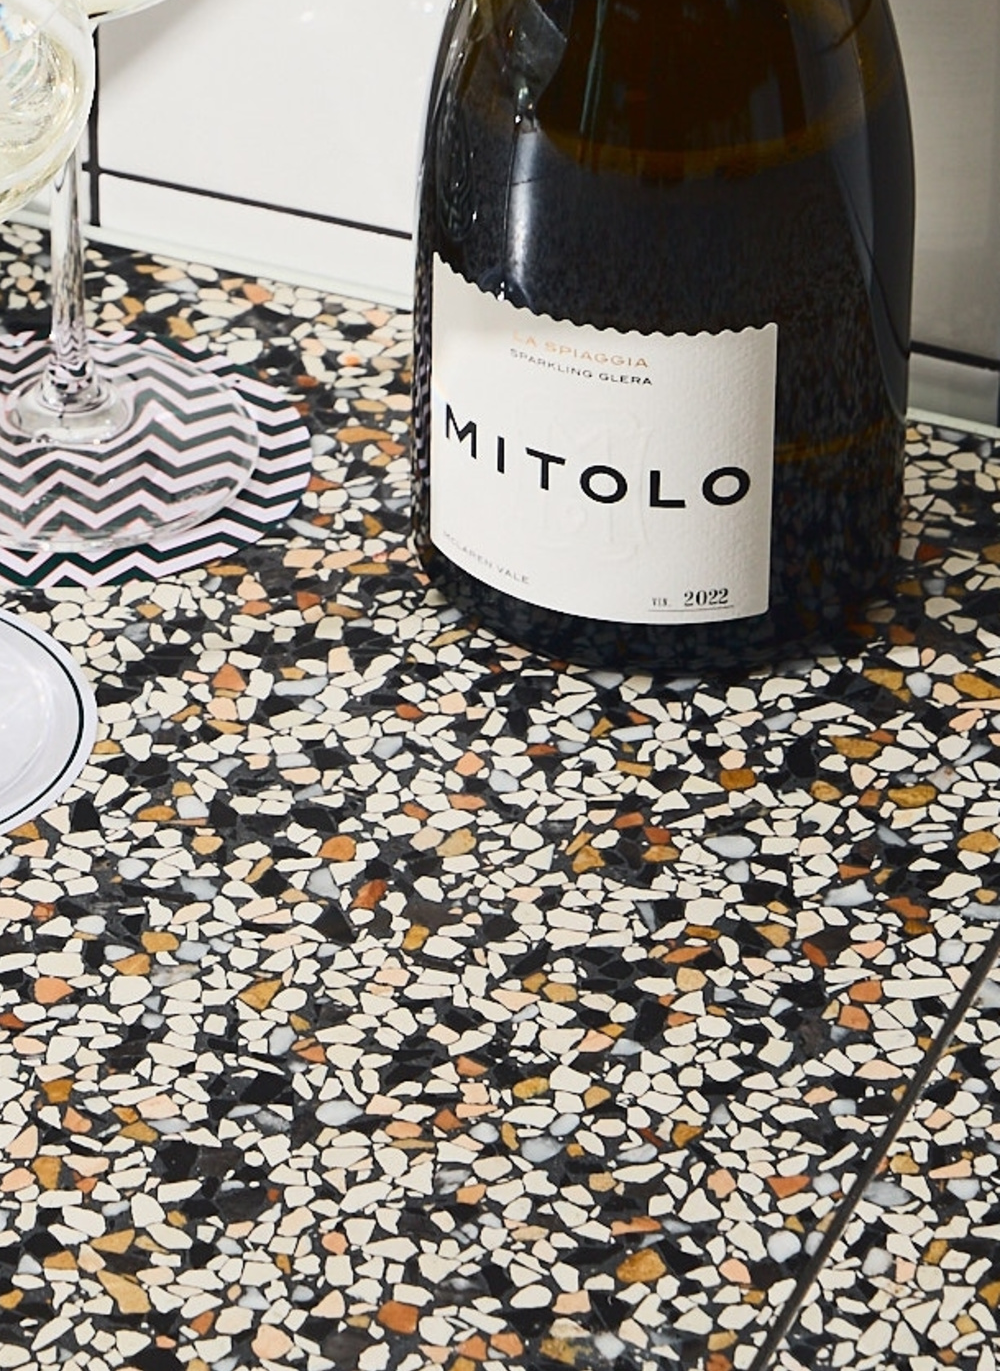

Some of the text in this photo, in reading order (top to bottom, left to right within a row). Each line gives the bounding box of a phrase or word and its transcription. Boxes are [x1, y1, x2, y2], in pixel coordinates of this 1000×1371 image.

[510, 348, 653, 385] SPARKLING GLERA
[512, 331, 648, 368] LA SPIAGGIA
[446, 403, 751, 509] MITOLO
[497, 565, 529, 585] VALE
[683, 587, 729, 607] 2022
